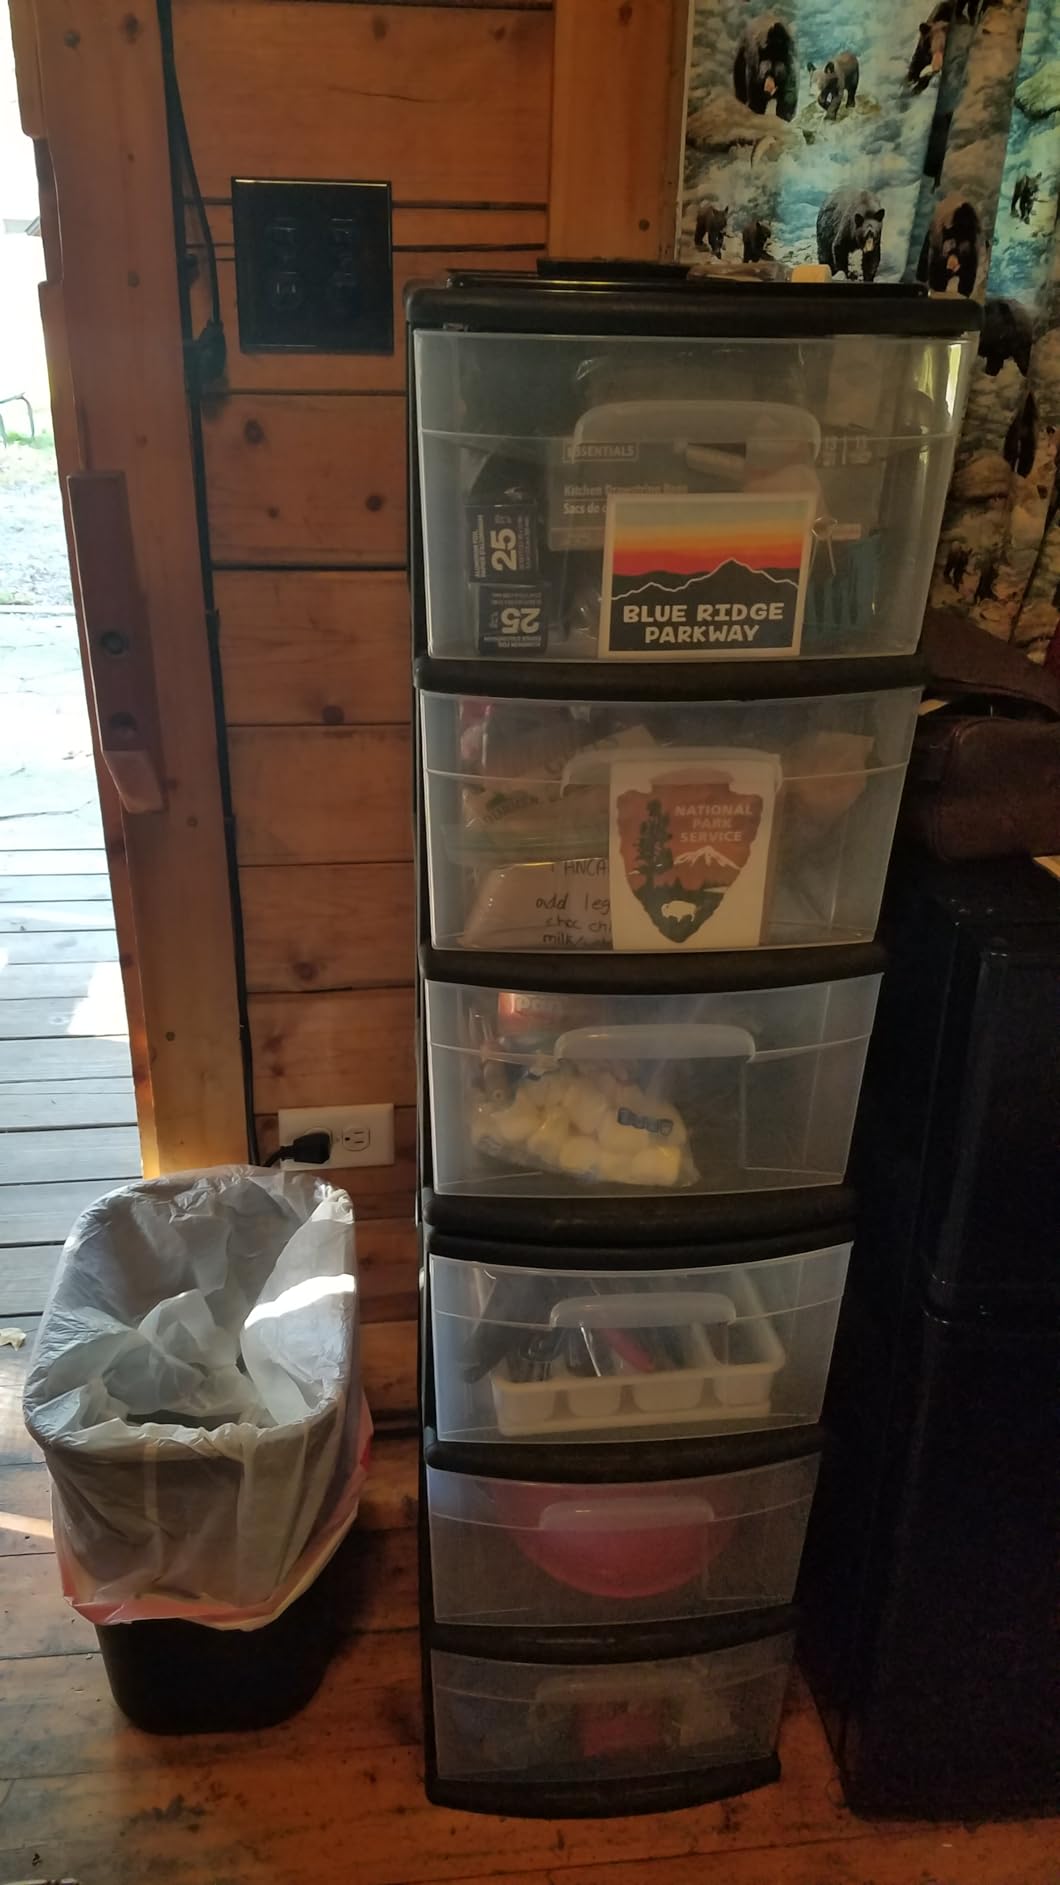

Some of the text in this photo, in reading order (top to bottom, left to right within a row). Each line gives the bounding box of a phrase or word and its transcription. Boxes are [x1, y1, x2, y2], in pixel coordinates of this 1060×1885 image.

[489, 528, 517, 571] 25
[500, 607, 541, 635] 25
[623, 602, 785, 623] BLUE RIDGE
[644, 624, 760, 644] PARKWAY
[674, 803, 753, 817] NATIONAL
[692, 817, 733, 829] PARK
[680, 831, 743, 843] SERVICE
[535, 892, 569, 910] add
